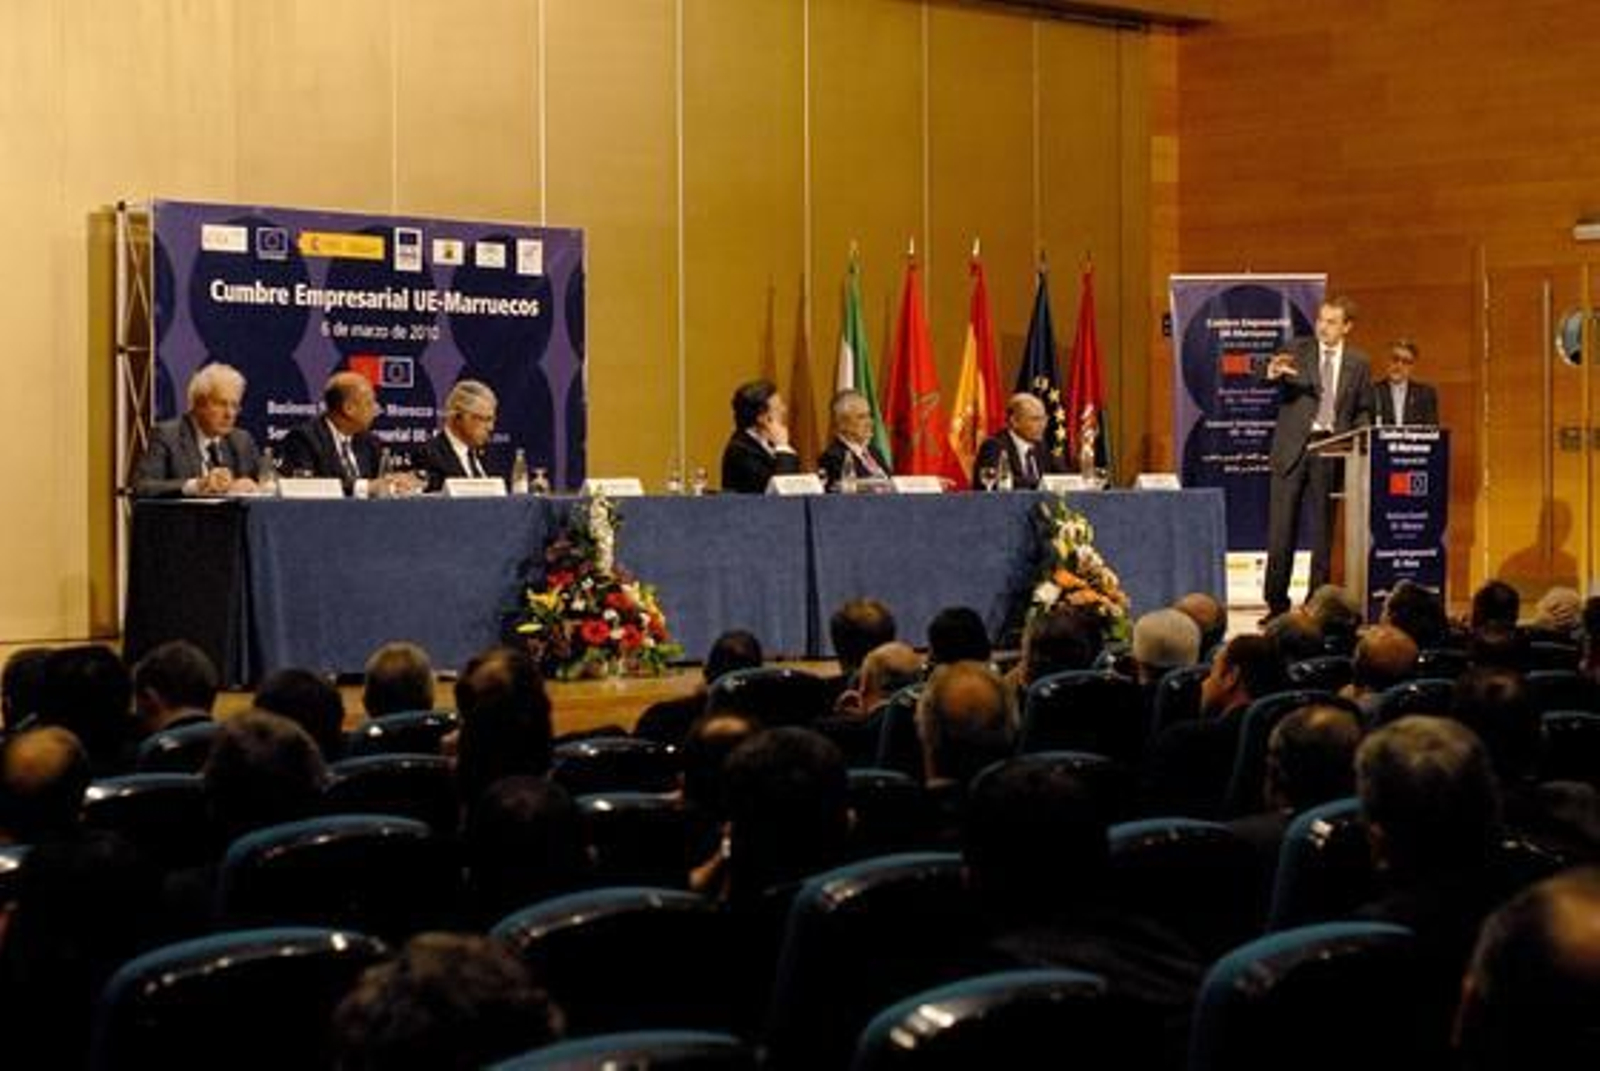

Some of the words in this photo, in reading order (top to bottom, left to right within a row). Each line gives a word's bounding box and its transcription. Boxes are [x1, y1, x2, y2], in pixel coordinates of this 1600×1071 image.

[209, 278, 290, 305] Cumbre
[295, 283, 409, 313] Empresarial
[413, 289, 540, 317] UE-Marruecos
[333, 321, 349, 338] de
[351, 324, 389, 340] marzo
[391, 324, 408, 341] de
[409, 325, 441, 341] 2010
